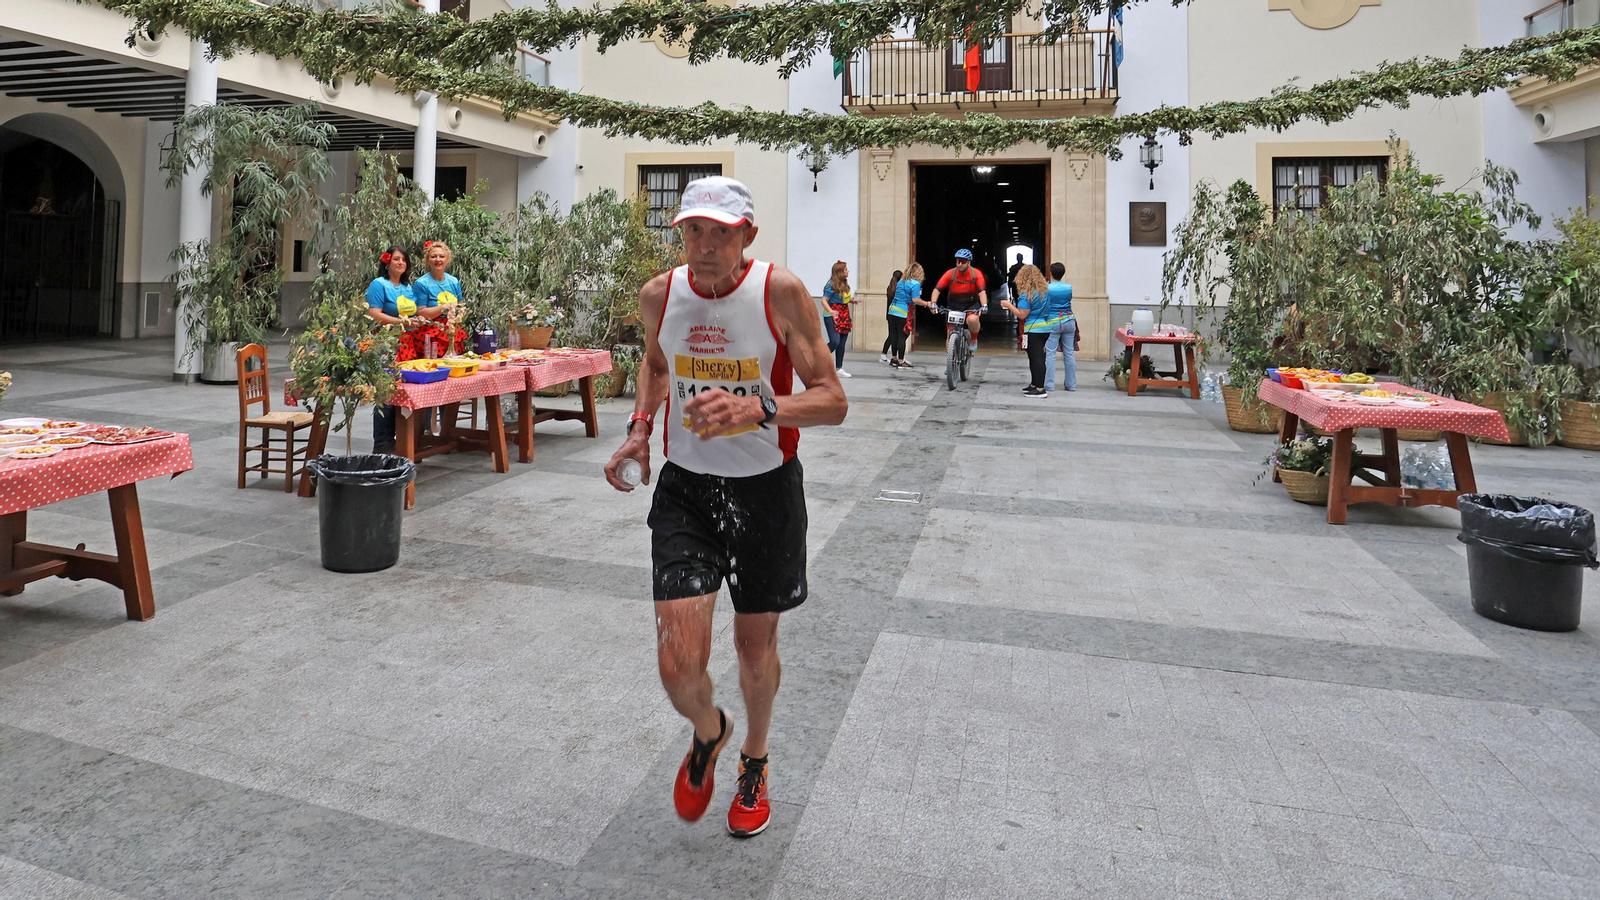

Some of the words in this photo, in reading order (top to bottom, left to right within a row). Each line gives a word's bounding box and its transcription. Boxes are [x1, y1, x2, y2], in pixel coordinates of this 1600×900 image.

[690, 326, 726, 334] ADELAIDE
[703, 333, 711, 342] A
[689, 346, 725, 354] HARRIERS
